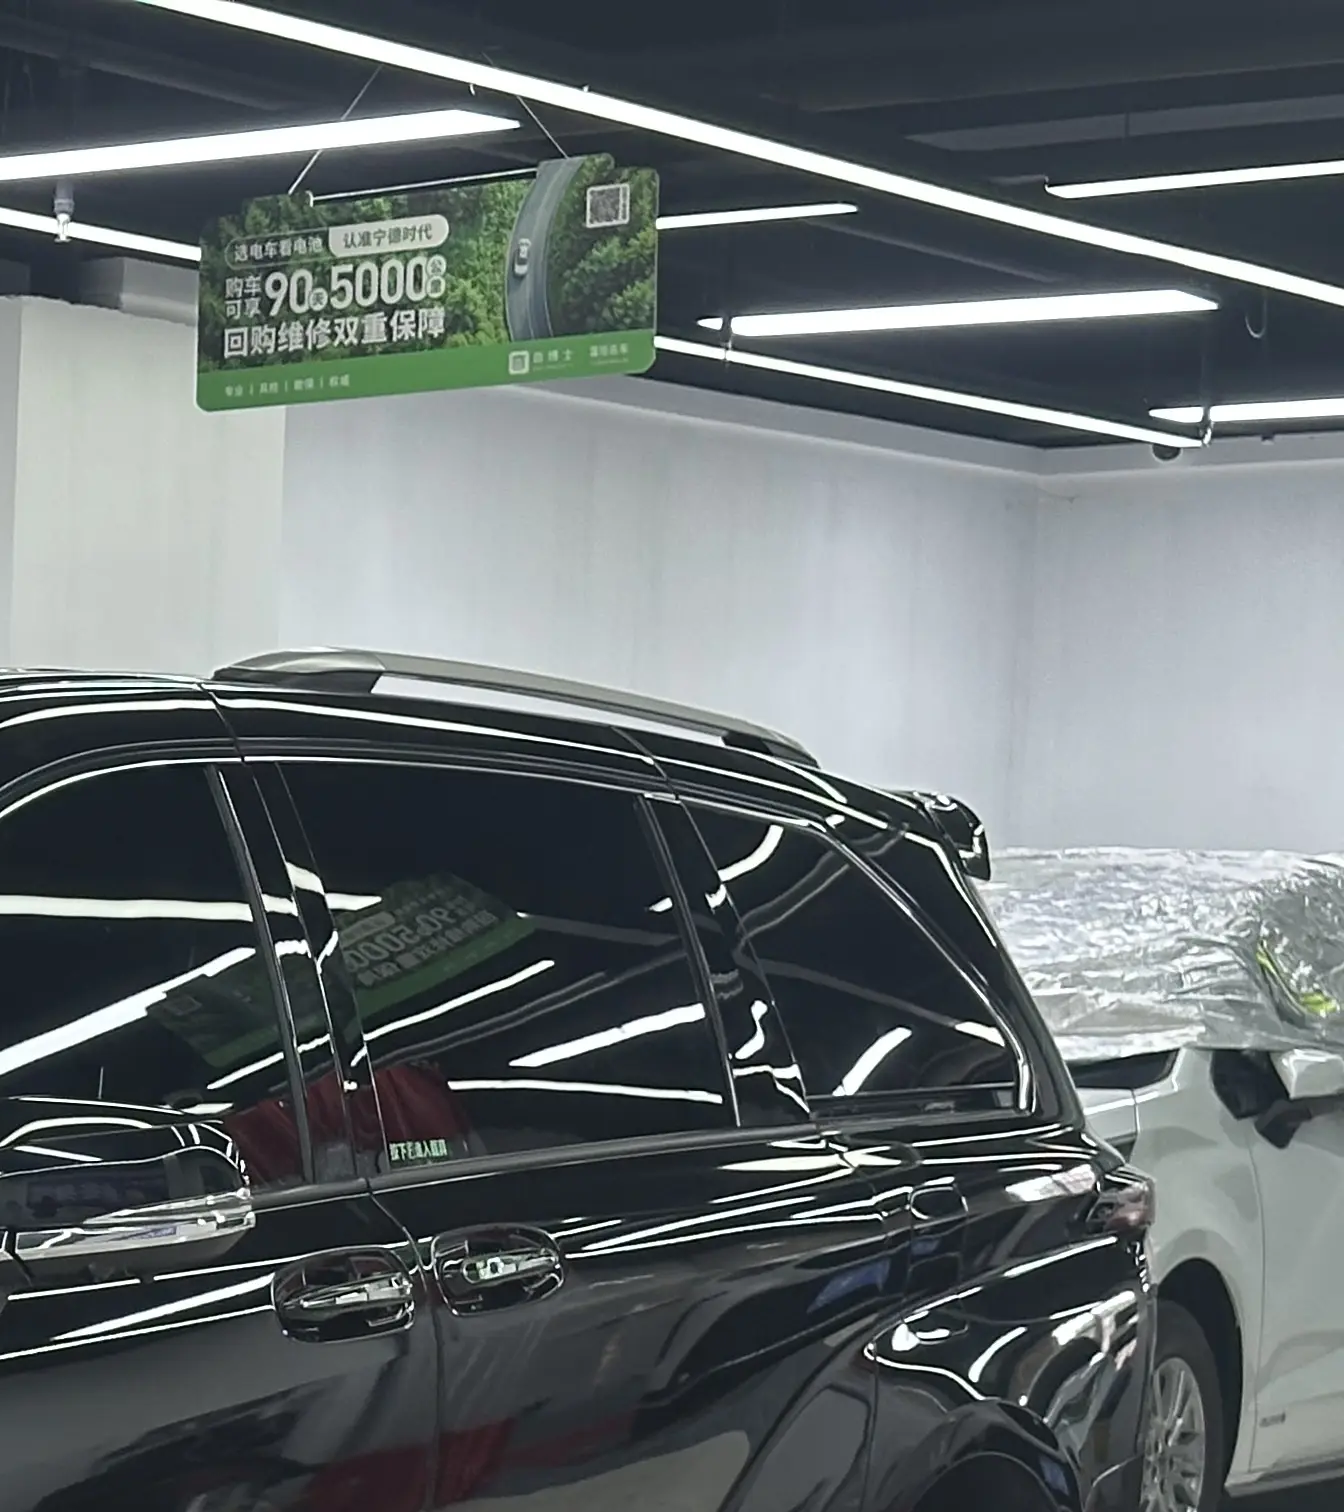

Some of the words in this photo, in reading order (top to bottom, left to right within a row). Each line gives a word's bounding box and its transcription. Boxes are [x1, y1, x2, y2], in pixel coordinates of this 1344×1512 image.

[224, 306, 445, 359] 回购维修双重保障
